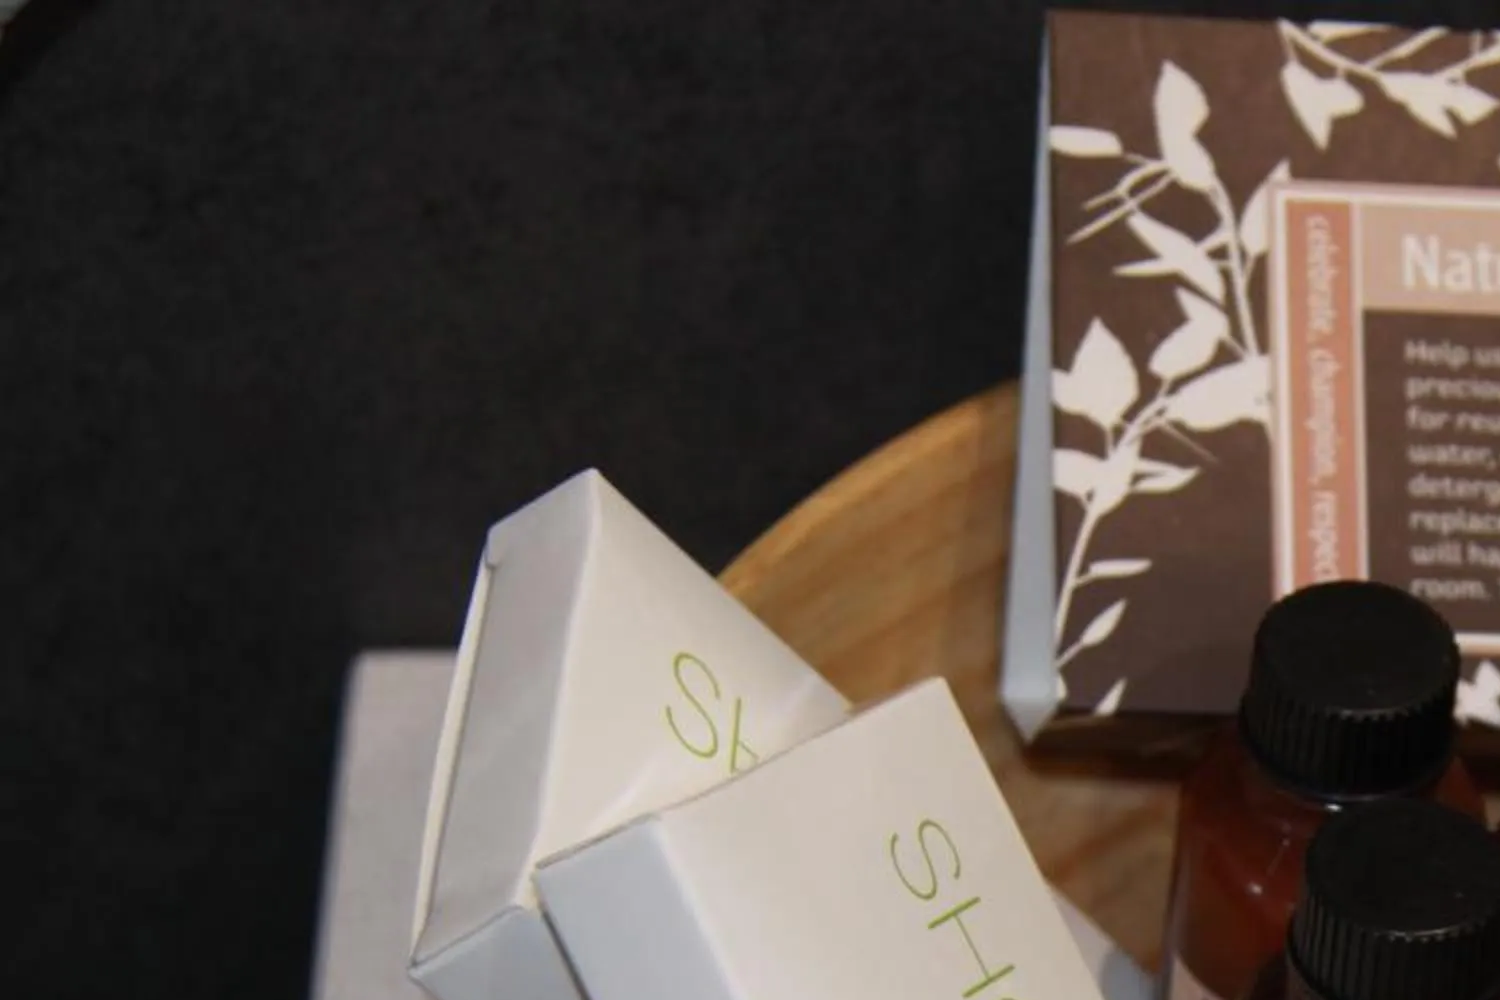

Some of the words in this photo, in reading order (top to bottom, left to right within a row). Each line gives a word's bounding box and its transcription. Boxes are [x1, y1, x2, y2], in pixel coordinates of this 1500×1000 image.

[1404, 339, 1469, 371] Help
[1405, 405, 1450, 431] for
[1407, 445, 1497, 471] water,
[1410, 542, 1462, 567] will
[1409, 577, 1492, 602] room.
